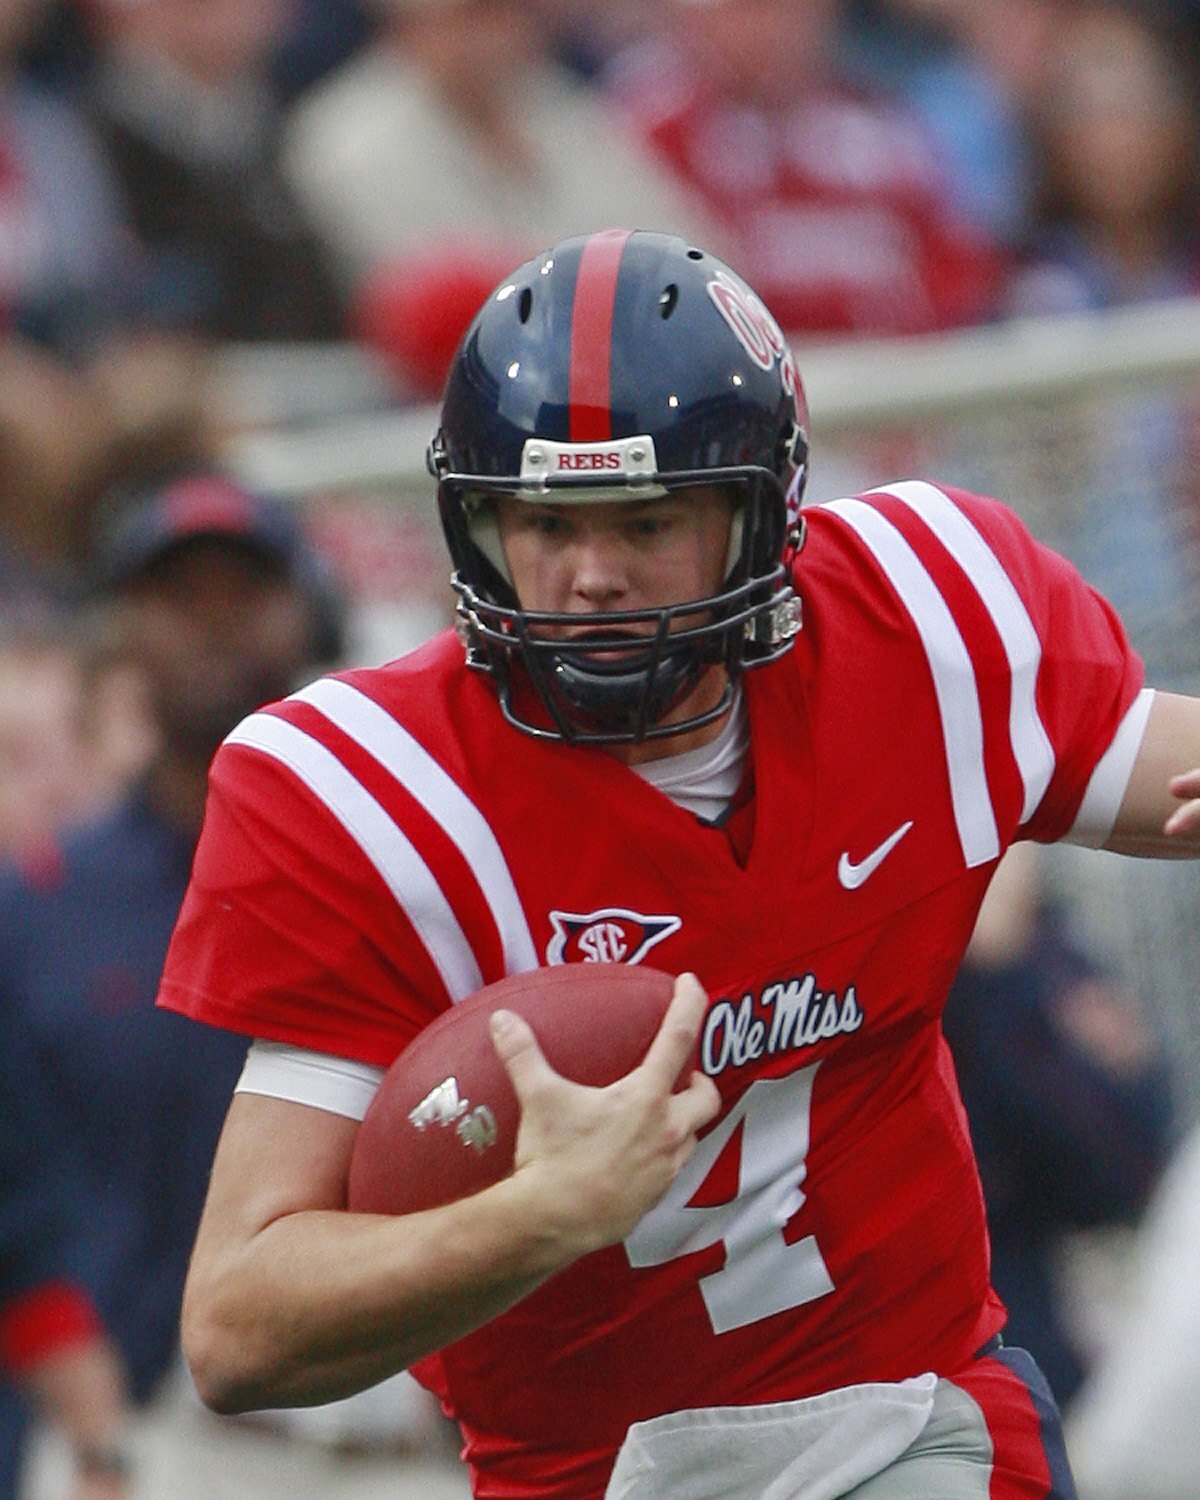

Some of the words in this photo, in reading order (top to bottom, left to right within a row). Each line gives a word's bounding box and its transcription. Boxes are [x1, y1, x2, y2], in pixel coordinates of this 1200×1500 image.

[558, 453, 621, 470] REBS
[578, 923, 628, 962] SEC
[701, 994, 767, 1077] Ole
[760, 974, 864, 1054] Miss
[624, 1059, 836, 1335] 4
